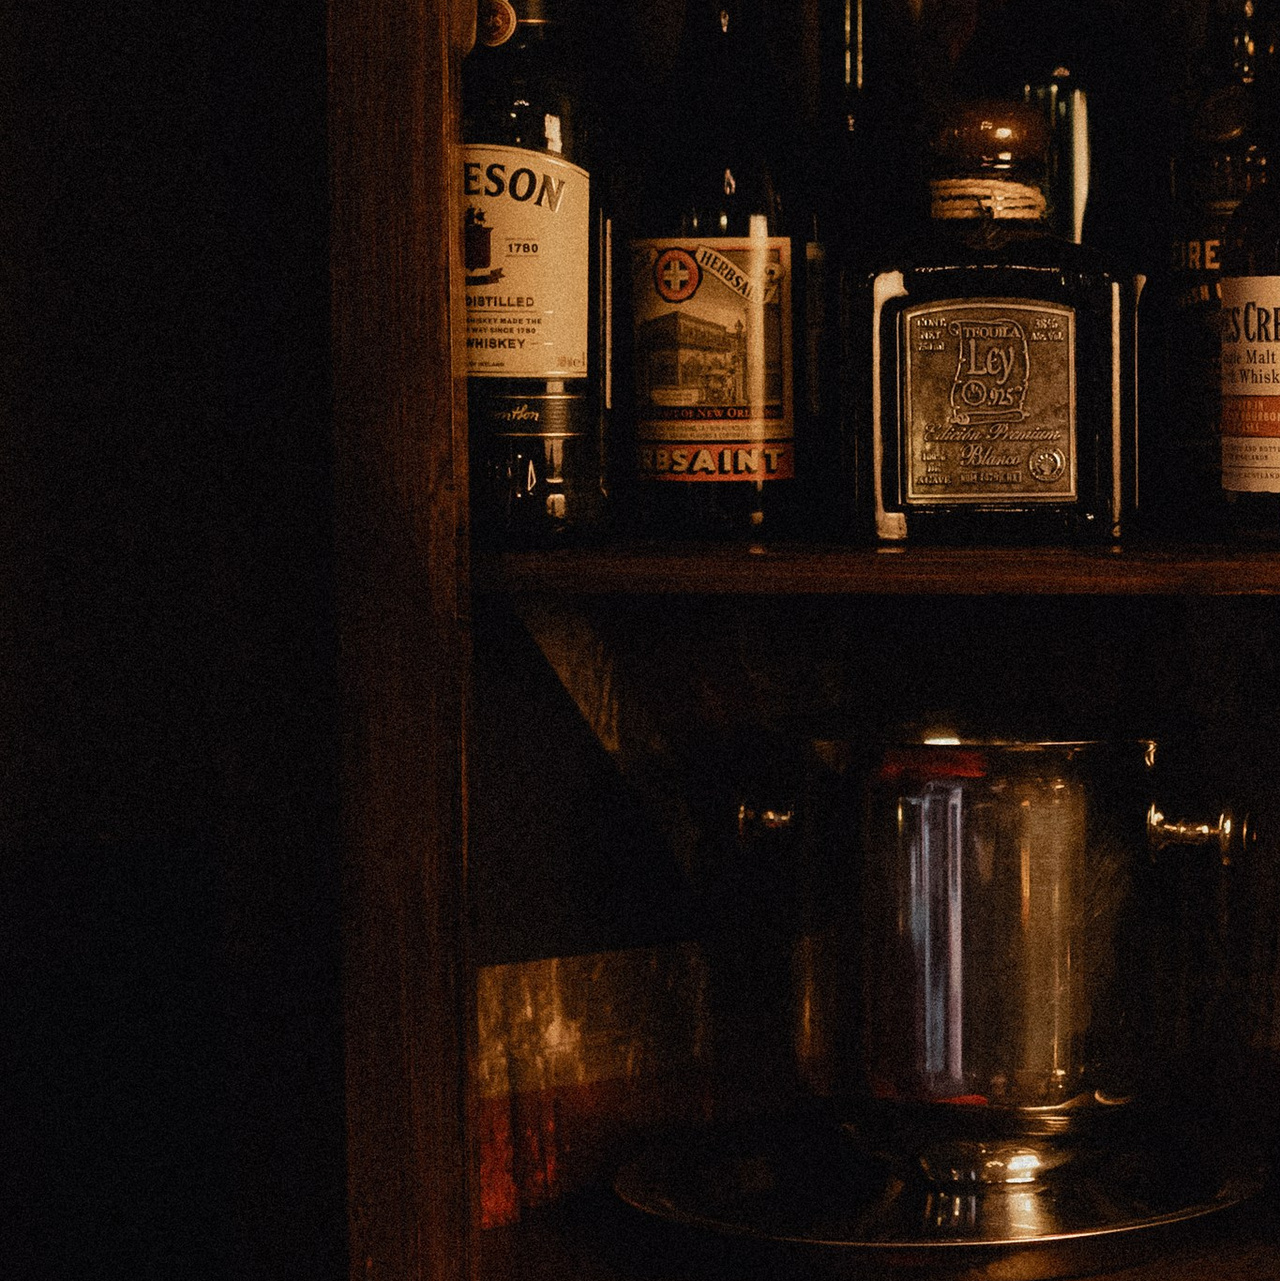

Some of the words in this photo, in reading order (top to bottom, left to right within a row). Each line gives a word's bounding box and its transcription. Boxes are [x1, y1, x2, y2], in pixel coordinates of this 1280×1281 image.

[464, 162, 565, 213] ESON
[508, 243, 539, 254] 1780
[964, 326, 1022, 339] TEQUILA
[967, 338, 1015, 385] Ley
[1246, 350, 1276, 364] Malt
[985, 422, 1062, 441] Premium
[960, 443, 1022, 467] Blanco
